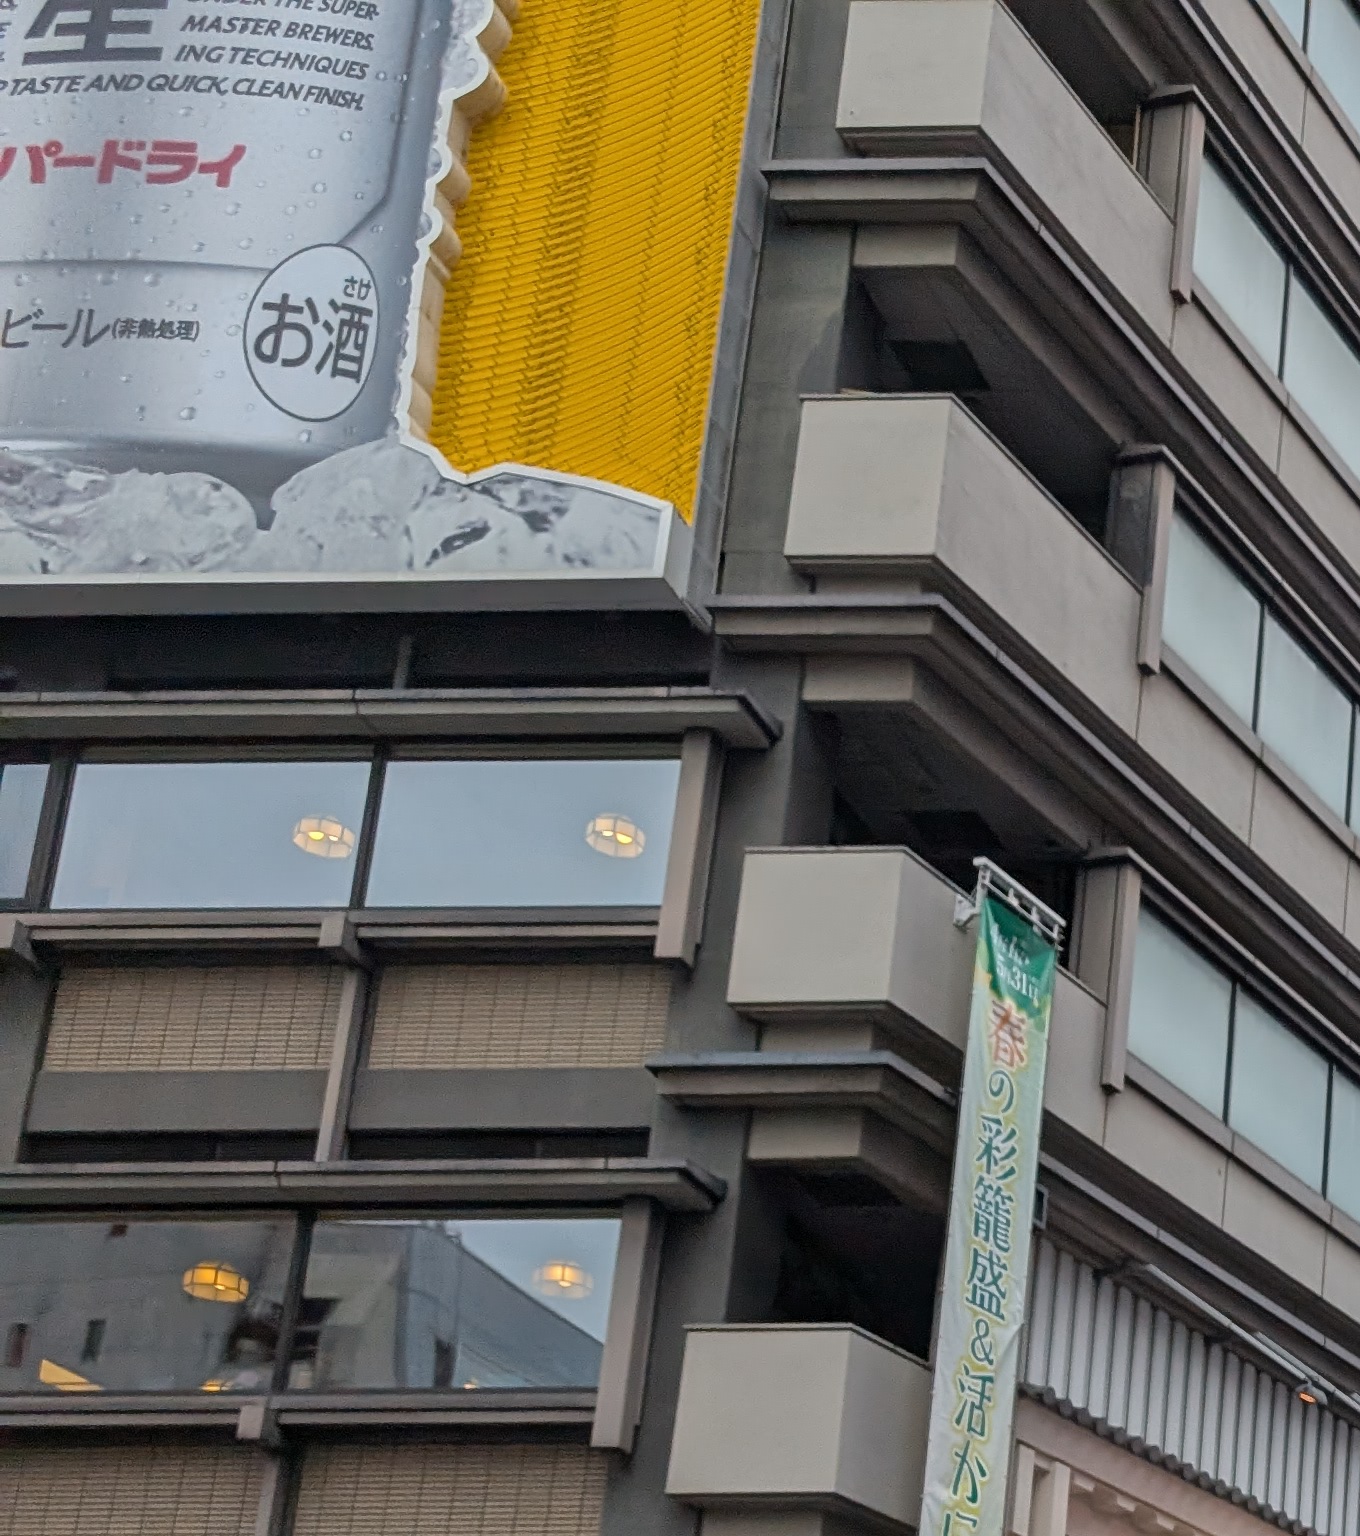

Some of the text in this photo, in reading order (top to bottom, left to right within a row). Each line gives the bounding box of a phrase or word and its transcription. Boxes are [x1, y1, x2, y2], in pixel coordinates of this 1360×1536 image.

[180, 15, 280, 37] MASTER
[175, 44, 370, 80] ING TECHNIQUES
[9, 75, 85, 96] TASTE
[89, 73, 146, 93] AND
[232, 78, 304, 102] CLEAN
[343, 276, 372, 299] さけ
[253, 293, 375, 384] お酒
